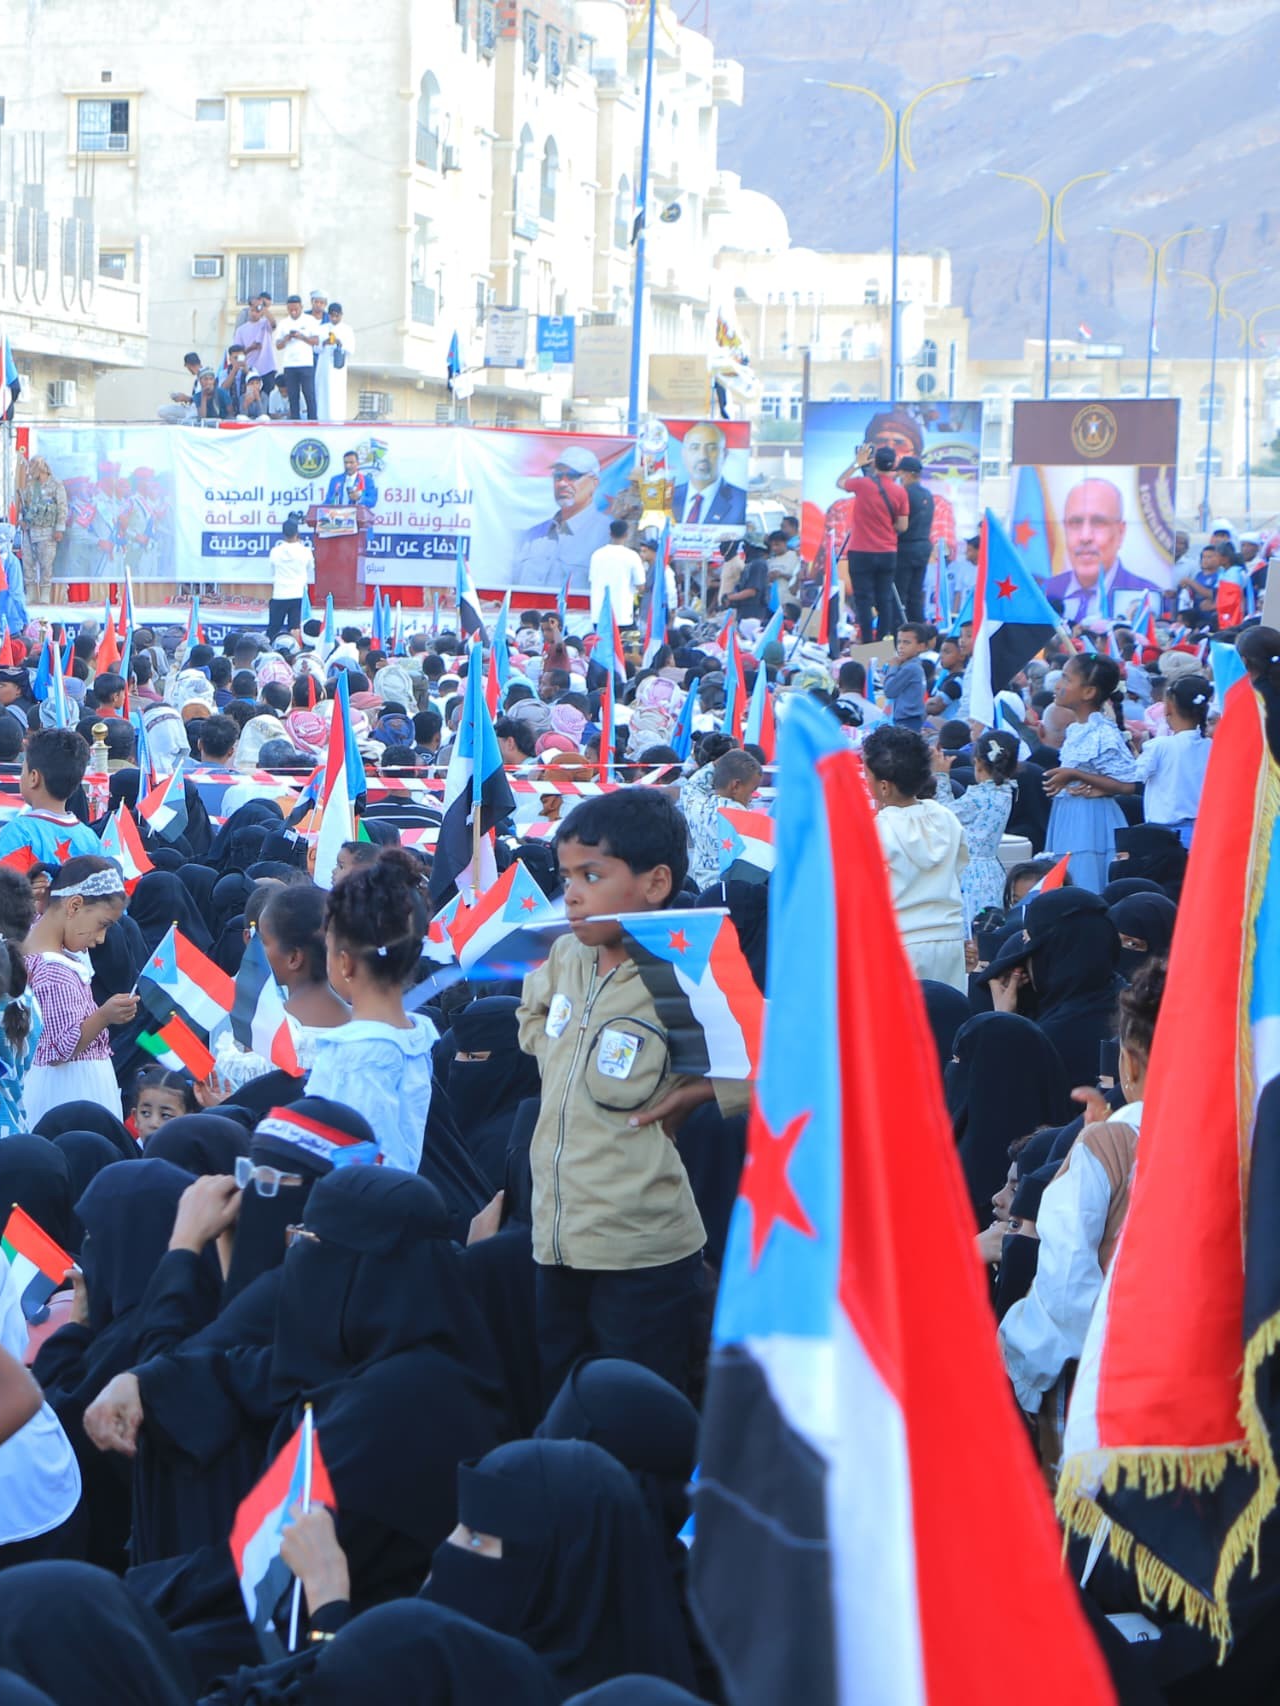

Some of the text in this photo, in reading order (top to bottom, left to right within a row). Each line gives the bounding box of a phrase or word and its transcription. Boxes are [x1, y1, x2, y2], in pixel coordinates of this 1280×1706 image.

[205, 487, 263, 506] المجيدة
[268, 483, 314, 506] أكتوبر
[421, 489, 472, 508] الذكرى
[209, 536, 271, 556] الوطنية
[396, 538, 419, 556] عن
